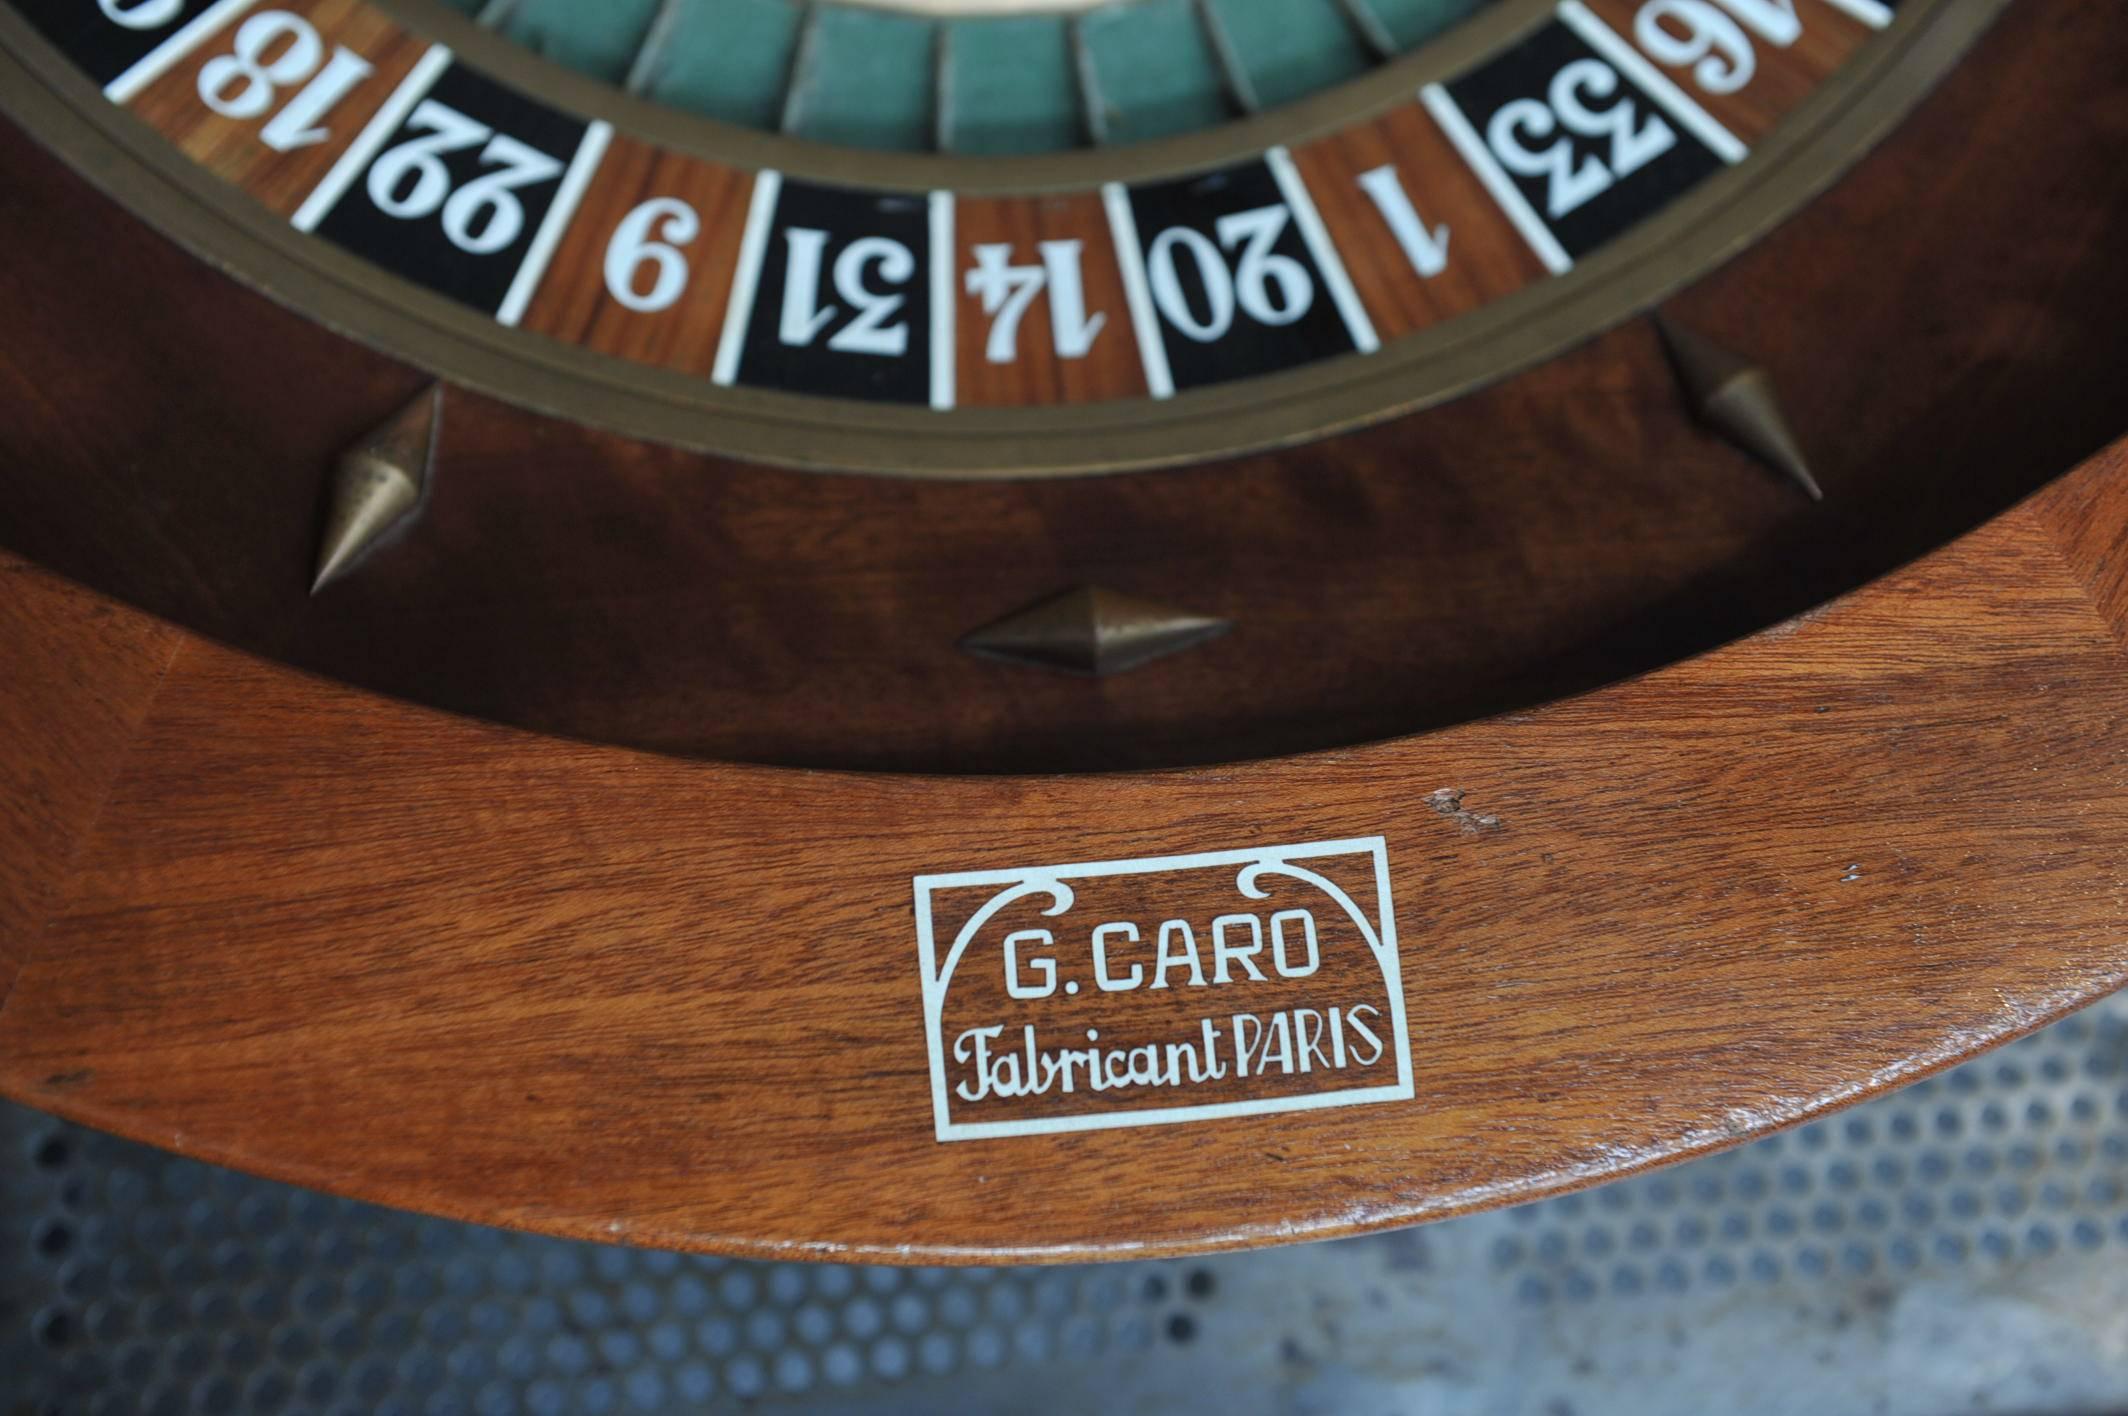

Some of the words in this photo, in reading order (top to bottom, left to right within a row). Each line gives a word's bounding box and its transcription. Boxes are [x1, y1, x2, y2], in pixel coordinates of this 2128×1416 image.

[197, 10, 374, 152] 18
[1486, 57, 1678, 219] 33
[366, 100, 564, 254] 22
[1356, 163, 1451, 278] 1
[603, 197, 700, 312] 9
[779, 228, 914, 355] 31
[964, 239, 1106, 362] 14
[1147, 202, 1314, 342] 20
[1003, 928, 1080, 1000] G.
[1091, 908, 1321, 993] CARO
[953, 1018, 1228, 1101] Fabricant
[1231, 1003, 1384, 1078] PARIS
